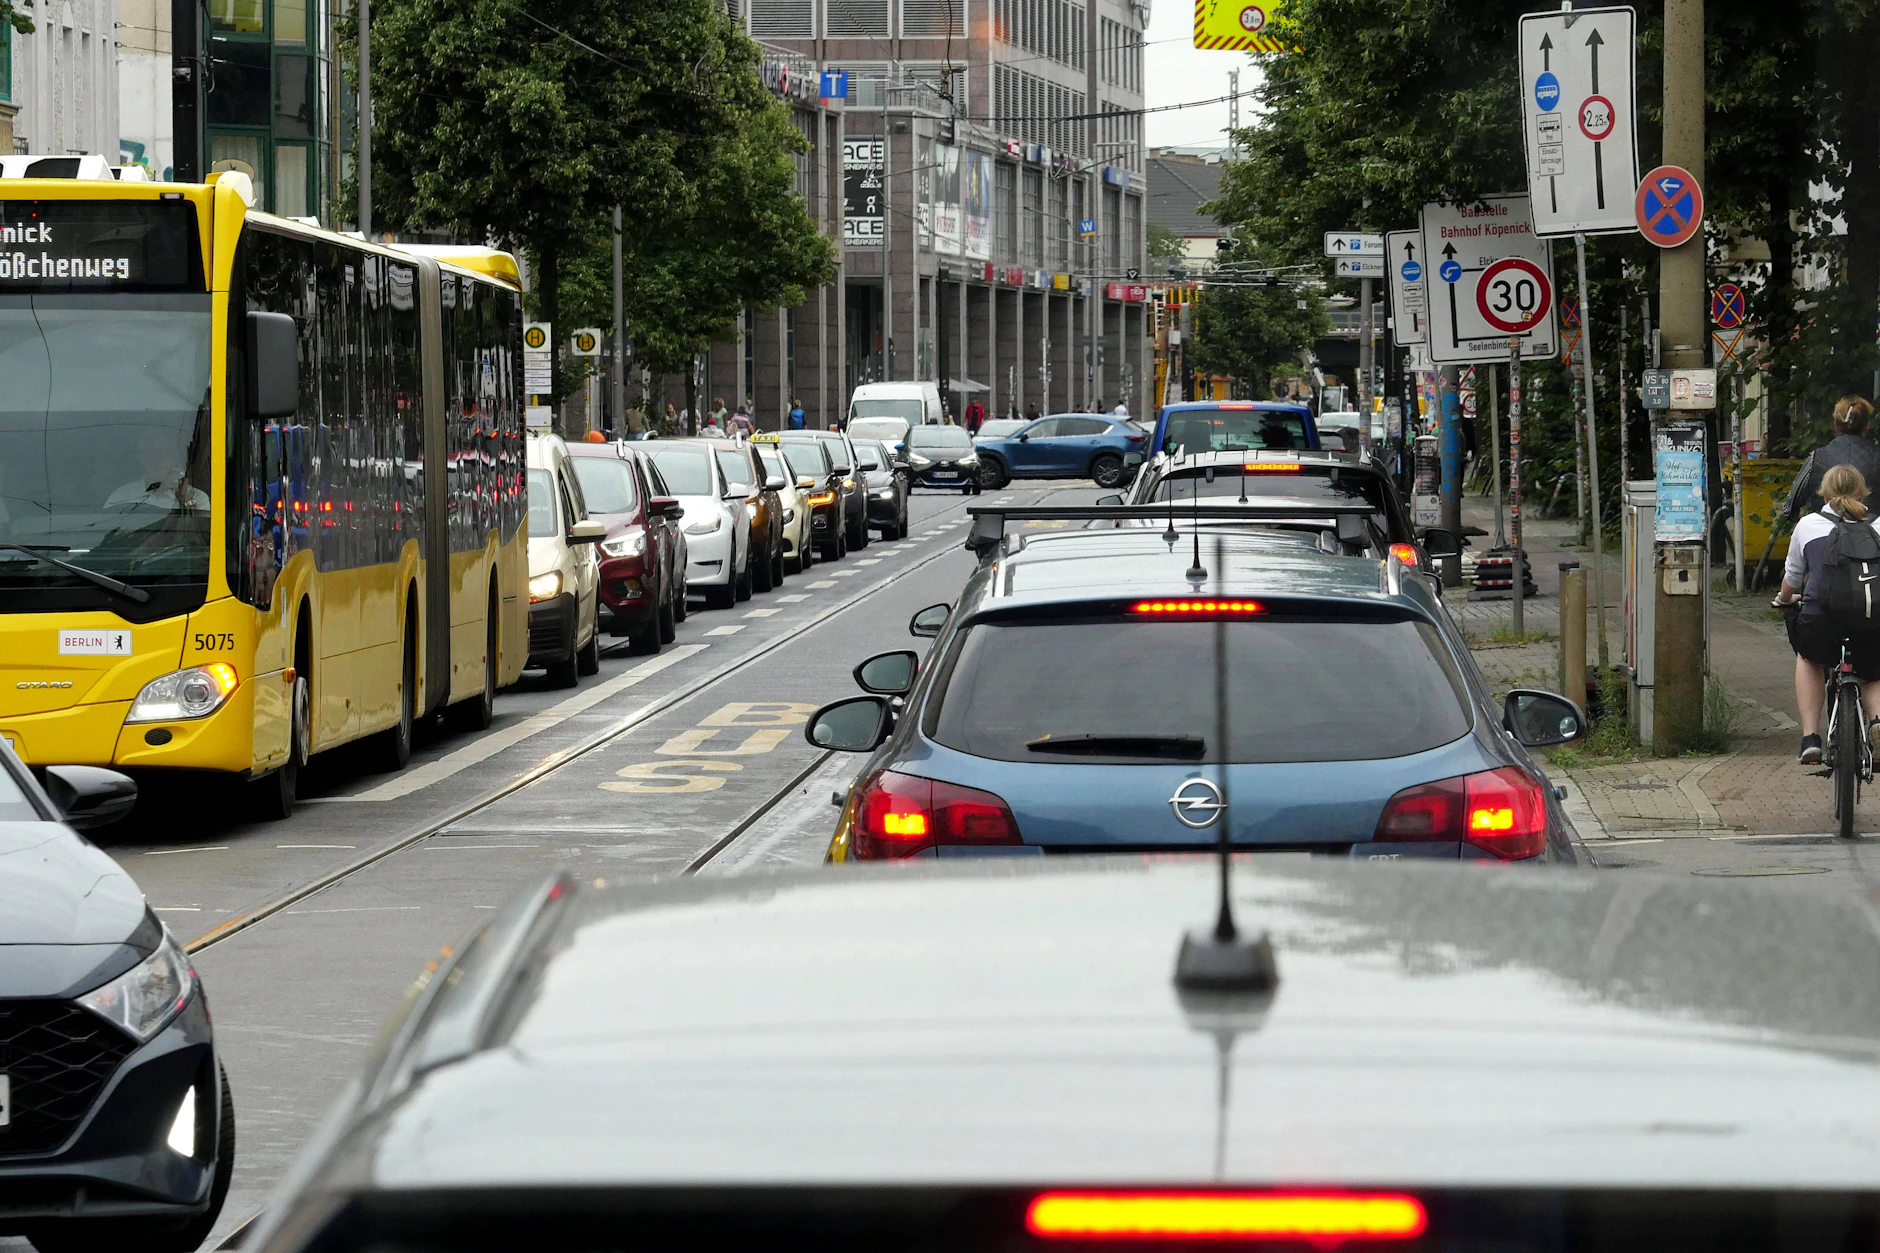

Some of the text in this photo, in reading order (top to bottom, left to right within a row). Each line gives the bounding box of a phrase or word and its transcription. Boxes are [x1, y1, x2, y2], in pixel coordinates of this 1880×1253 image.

[826, 73, 842, 96] T
[0, 222, 53, 243] nick
[1081, 221, 1093, 232] W
[1440, 222, 1531, 238] Bahnhof Köpenick
[1492, 279, 1535, 312] 30
[530, 332, 540, 344] H
[1645, 375, 1657, 384] VS
[64, 637, 103, 647] BERLIN
[194, 633, 235, 651] 5075
[16, 681, 73, 690] CITARO
[597, 702, 819, 793] BUS
